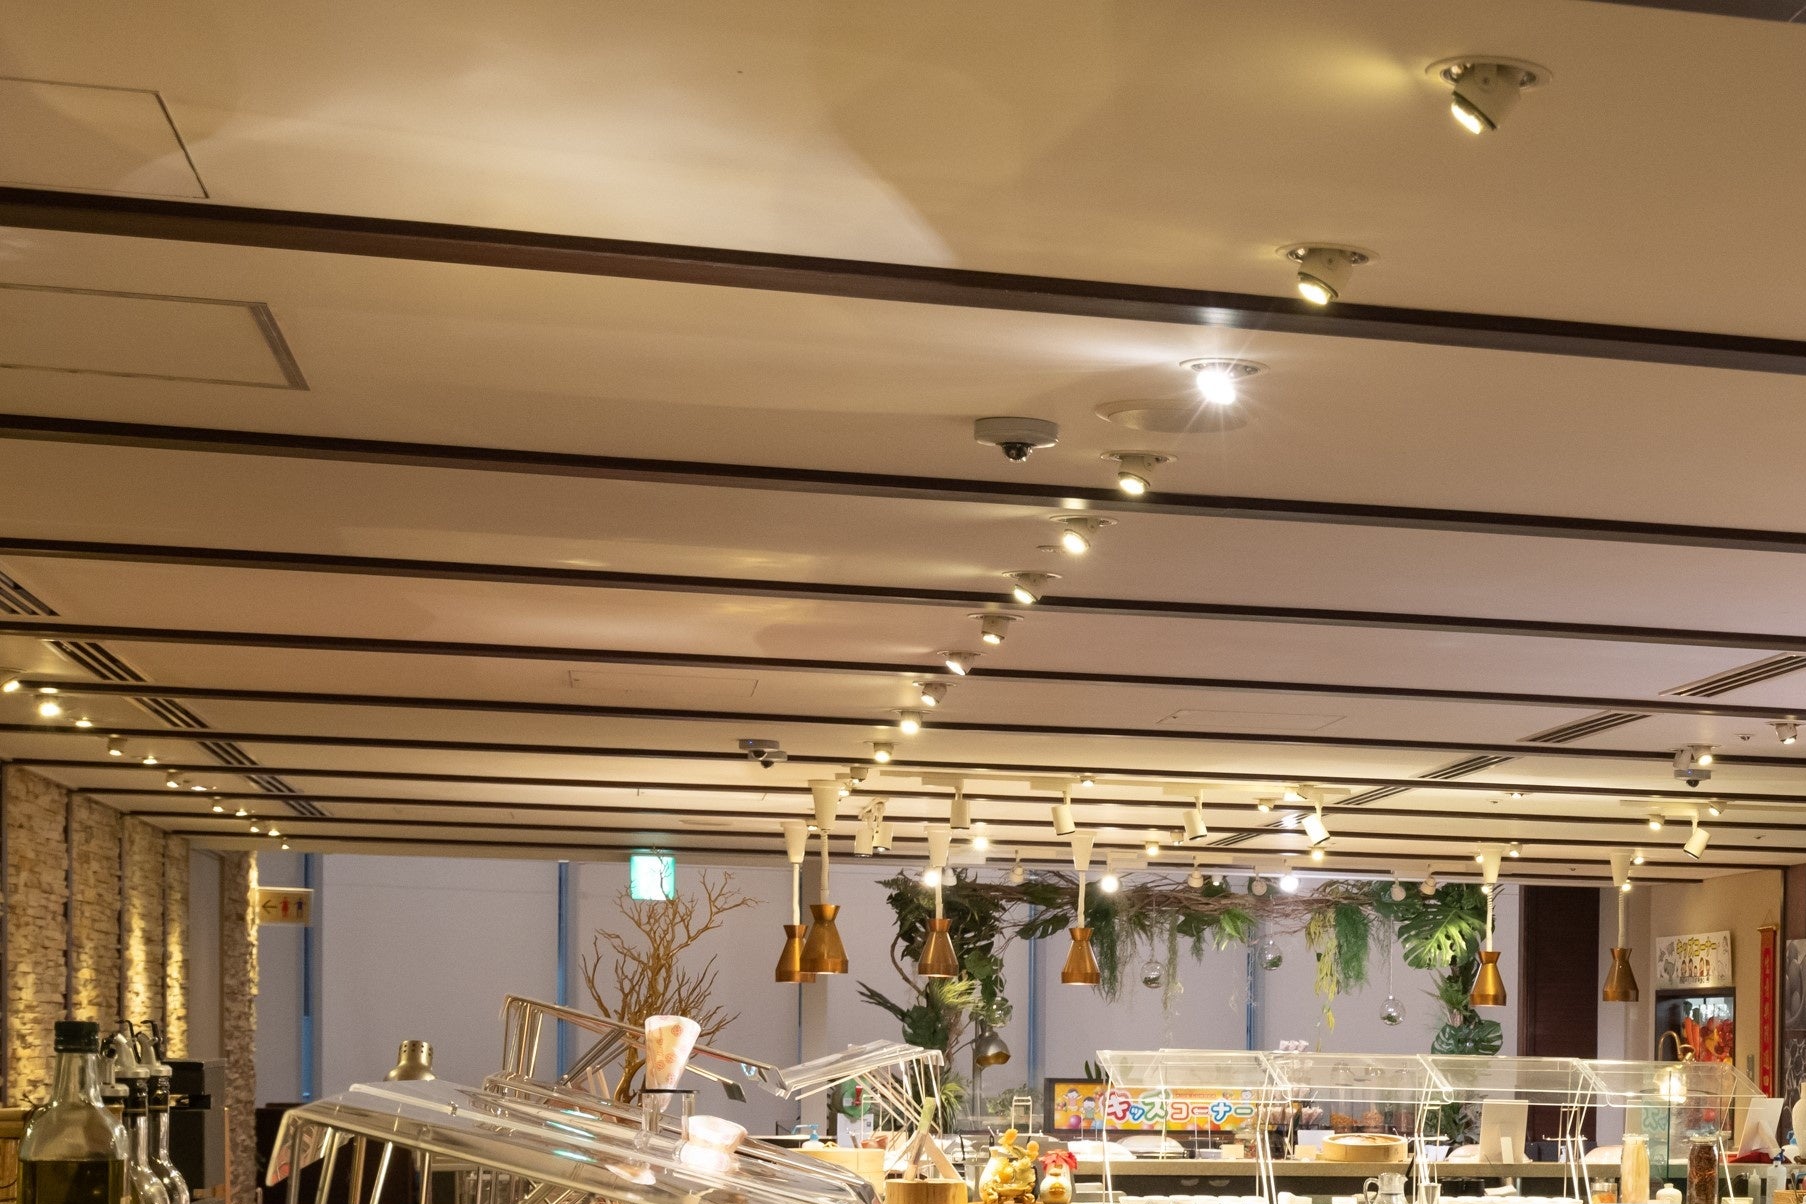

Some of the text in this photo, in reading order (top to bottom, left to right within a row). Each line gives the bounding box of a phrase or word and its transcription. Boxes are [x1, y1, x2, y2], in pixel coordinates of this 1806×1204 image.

[1104, 1088, 1254, 1123] キッズコーナー
